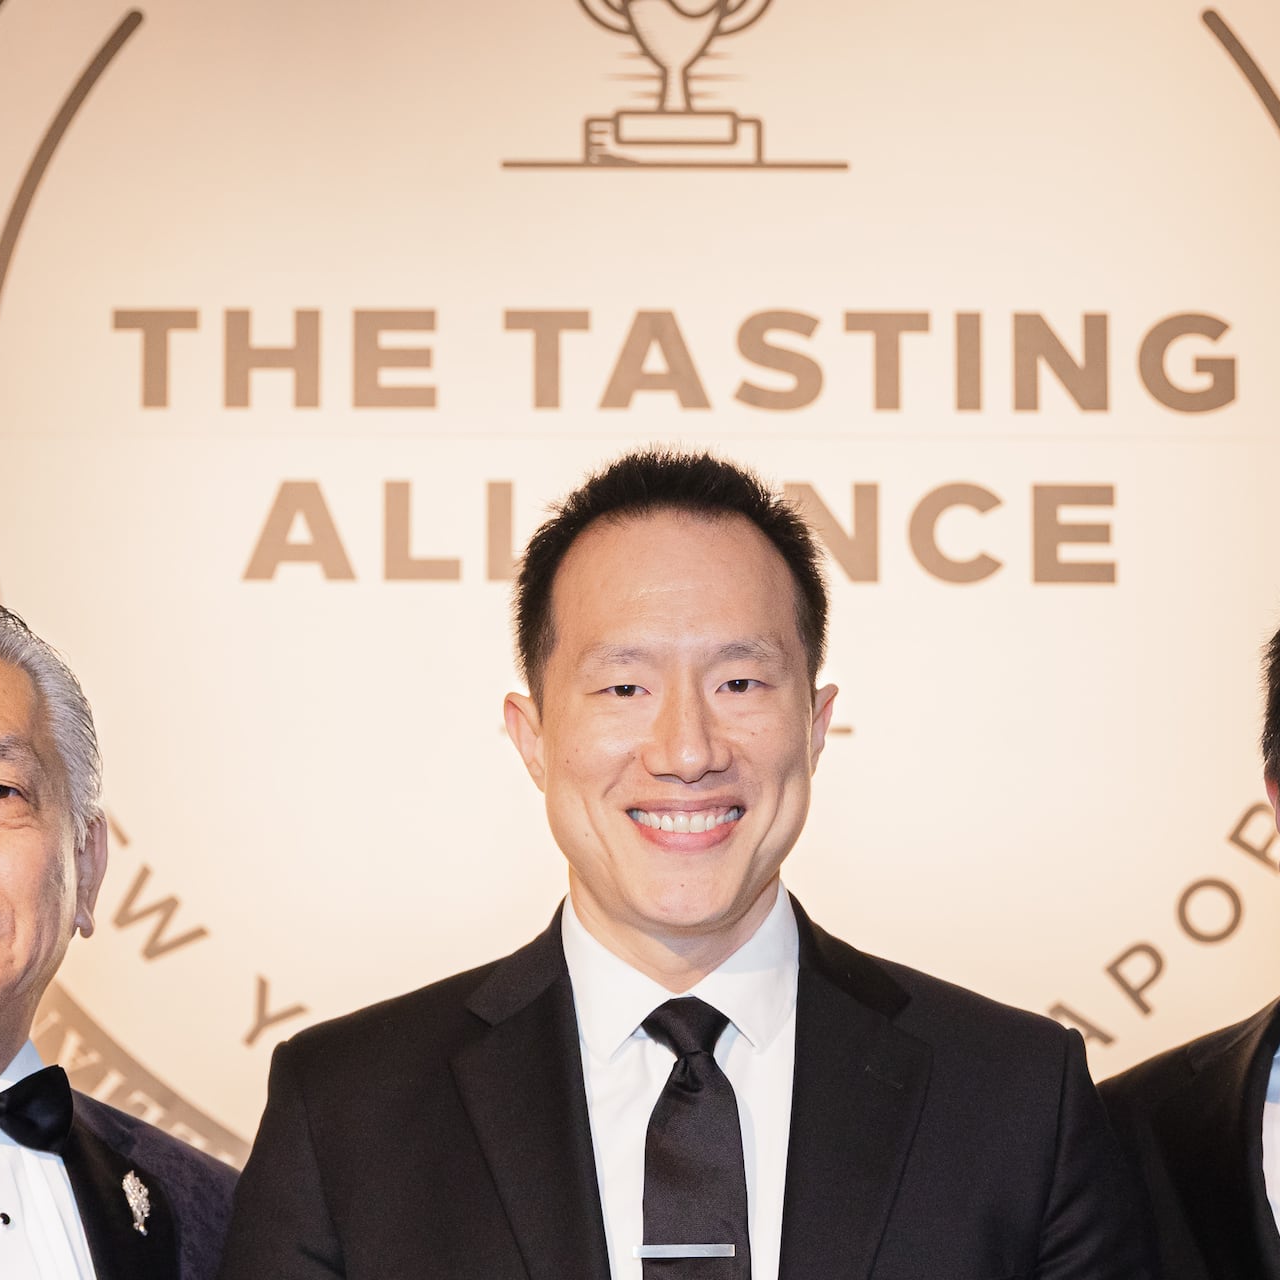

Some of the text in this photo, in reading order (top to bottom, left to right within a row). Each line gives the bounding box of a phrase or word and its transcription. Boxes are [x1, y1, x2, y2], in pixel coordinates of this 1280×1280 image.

[112, 308, 1238, 414] THE TASTING
[242, 480, 1119, 584] ALLNCE
